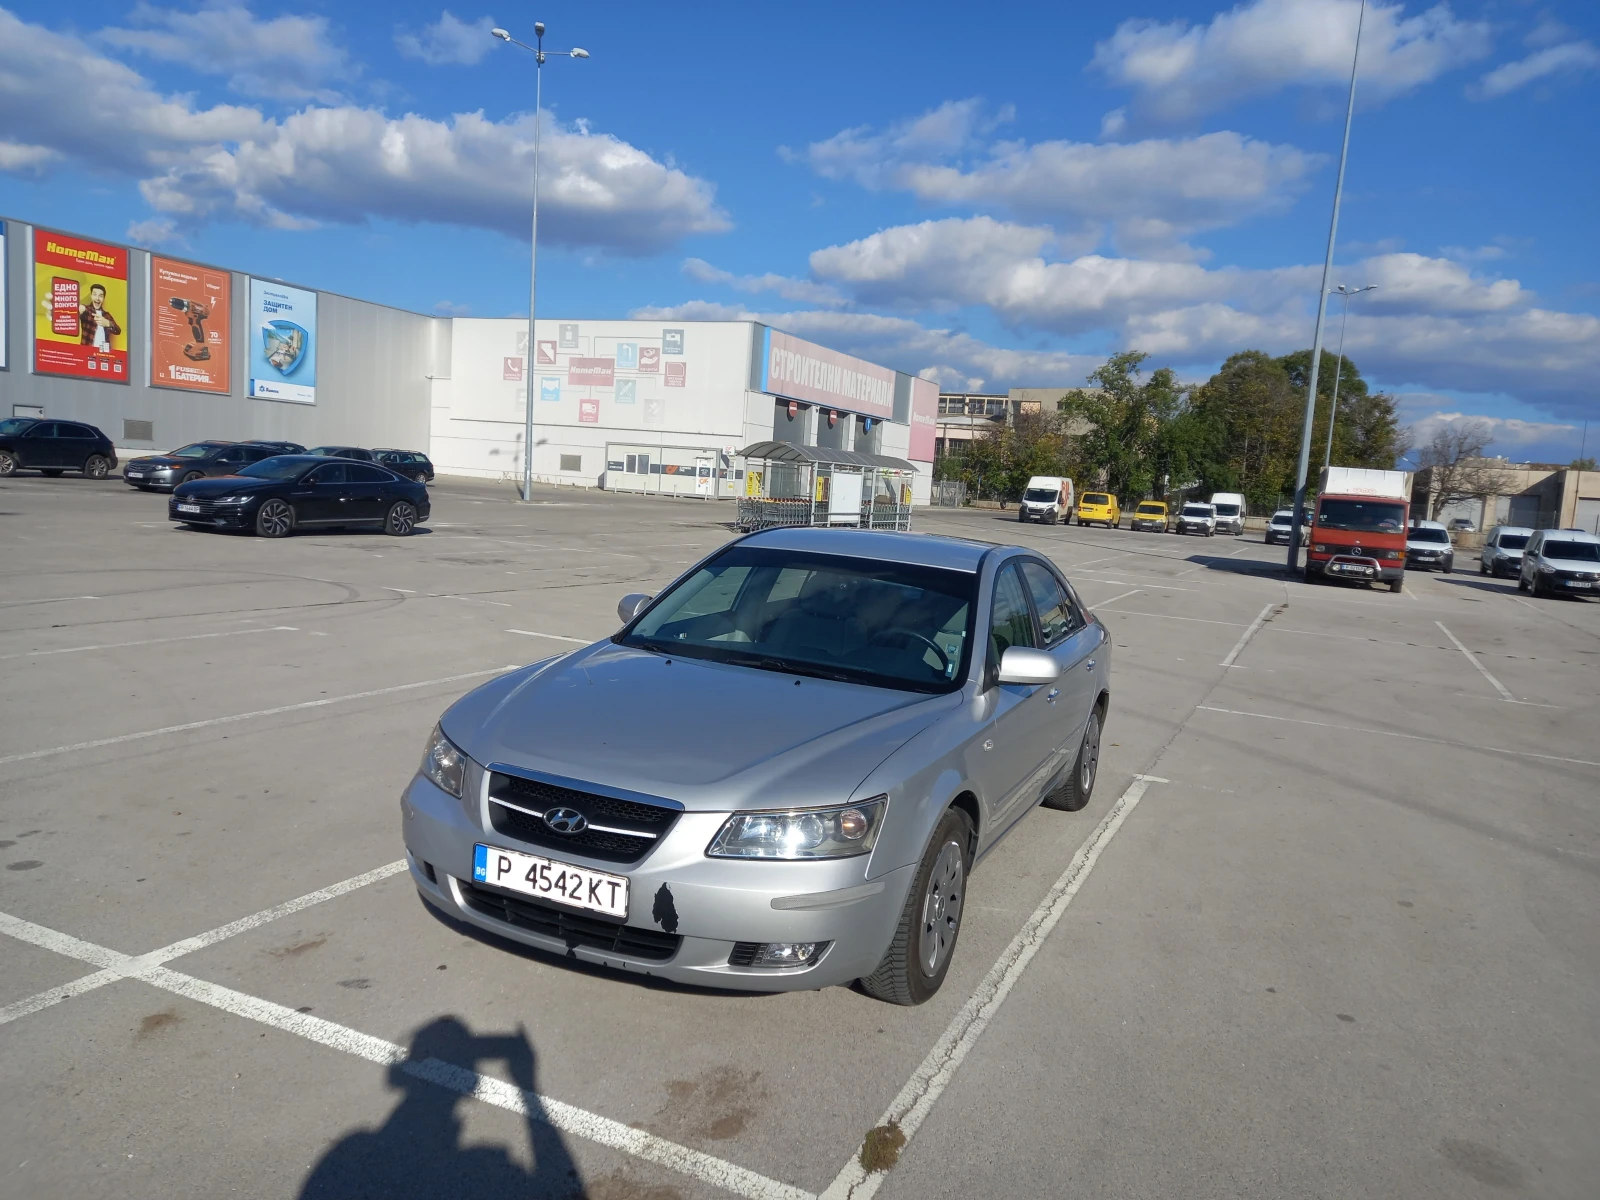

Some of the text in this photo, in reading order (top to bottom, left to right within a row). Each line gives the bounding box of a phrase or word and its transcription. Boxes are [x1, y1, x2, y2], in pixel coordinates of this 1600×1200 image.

[46, 241, 115, 265] HomeMax
[54, 283, 78, 293] ЕДНО
[263, 299, 293, 311] ЗАЩИТЕН
[263, 306, 278, 314] ДОМ
[168, 364, 176, 379] 1
[570, 366, 612, 375] HomeMax
[770, 347, 894, 408] СТРОИТЕЛНИ МАТЕРИАЛИ
[476, 866, 486, 876] BG
[497, 855, 512, 881] P
